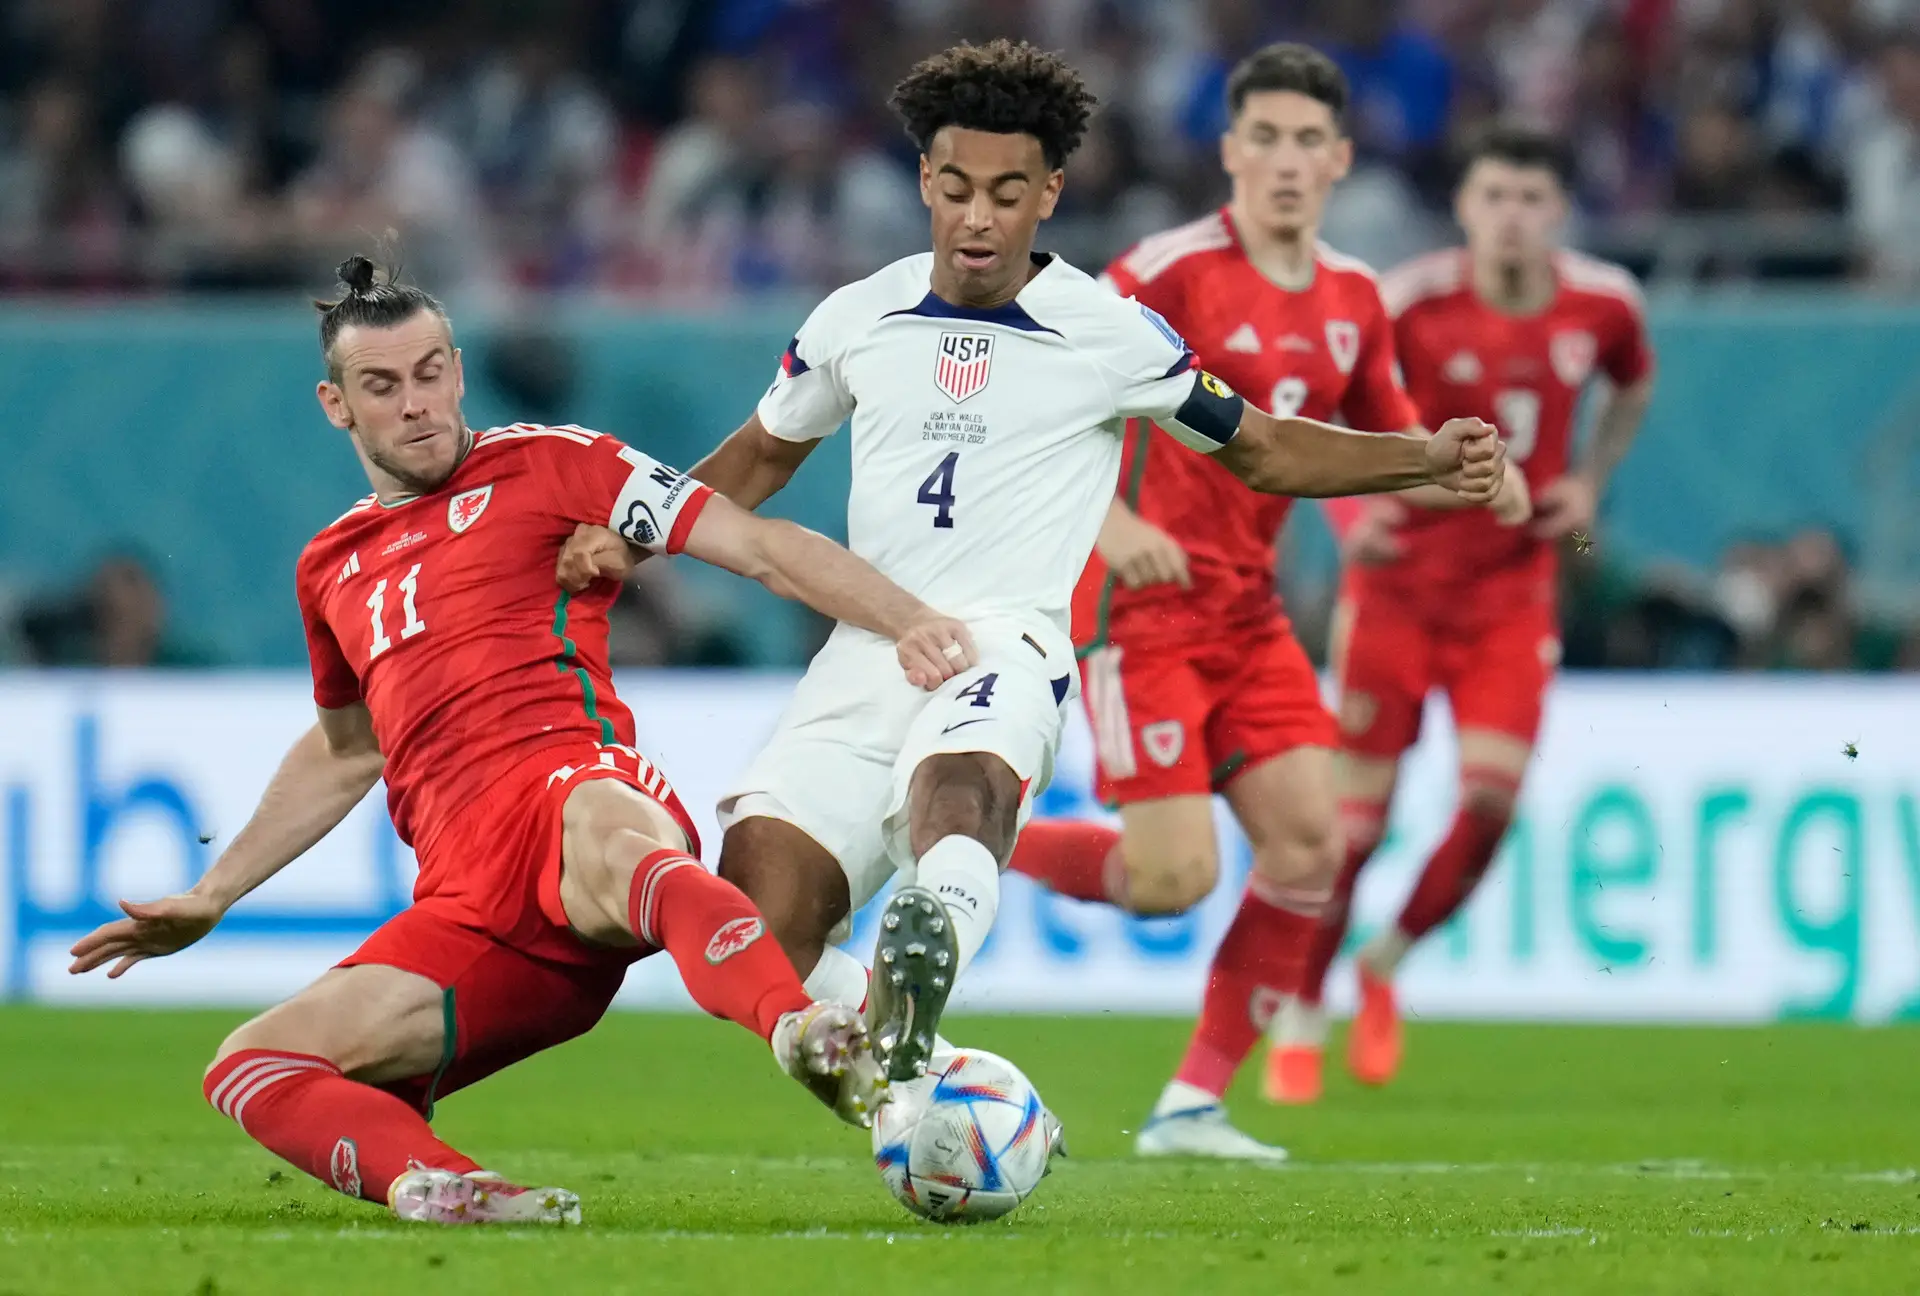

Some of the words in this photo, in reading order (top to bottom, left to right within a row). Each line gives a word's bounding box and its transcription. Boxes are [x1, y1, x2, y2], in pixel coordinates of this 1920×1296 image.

[943, 336, 990, 362] USA
[923, 421, 933, 431] AL
[935, 421, 961, 431] RAYYAN
[964, 423, 988, 434] QATAR
[930, 412, 944, 421] USA
[959, 413, 984, 423] WALES
[922, 431, 930, 441] 21
[931, 432, 966, 442] NOVEMBER
[967, 433, 986, 444] 2022
[917, 452, 960, 529] 4
[365, 563, 426, 661] 11
[954, 673, 999, 707] 4
[939, 885, 978, 910] USA
